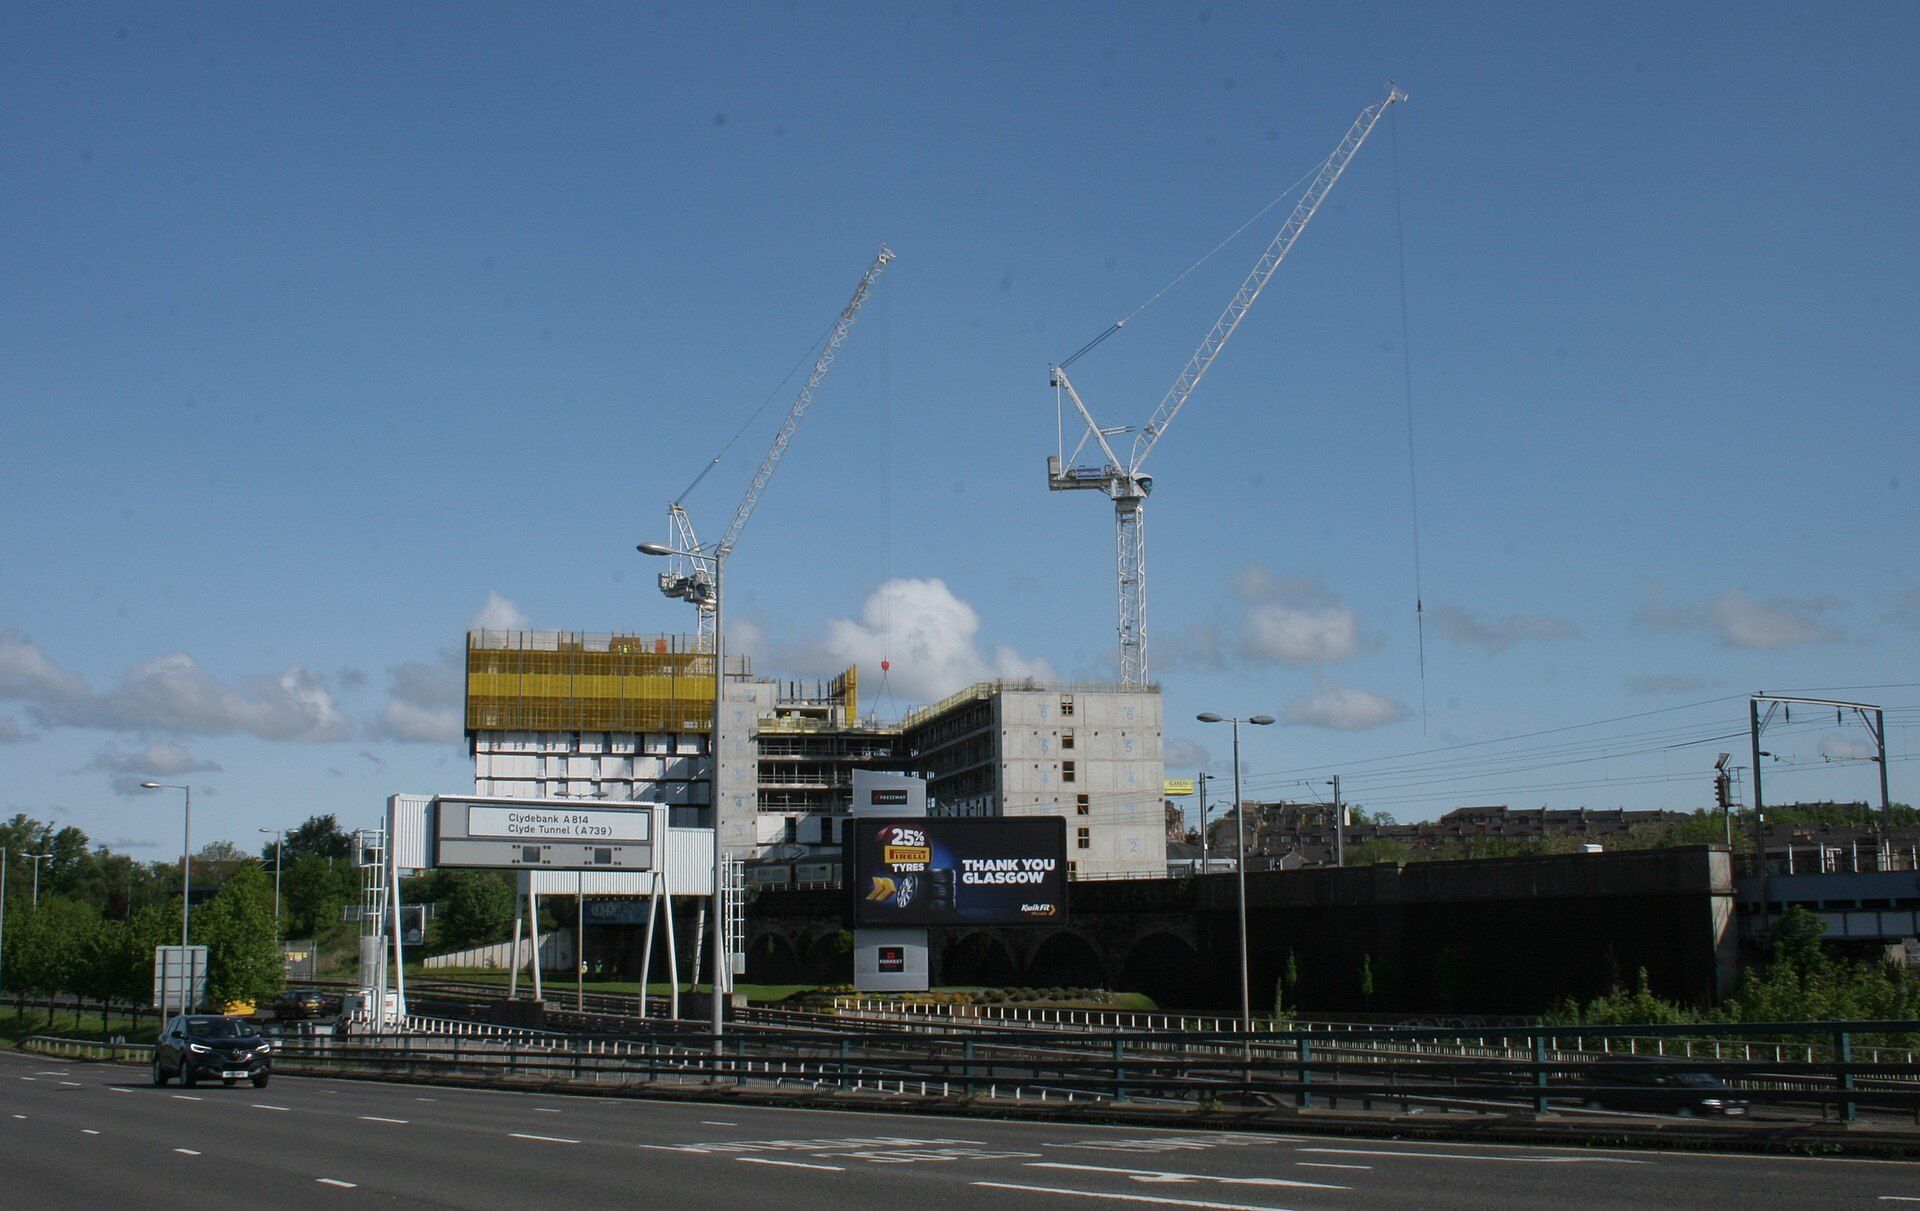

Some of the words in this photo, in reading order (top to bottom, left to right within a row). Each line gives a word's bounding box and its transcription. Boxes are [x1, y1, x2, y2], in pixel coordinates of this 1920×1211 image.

[508, 813, 559, 825] Clydebank
[508, 824, 535, 836] Clyde
[539, 825, 570, 835] Tunnel
[575, 826, 613, 836] (A739)
[891, 828, 925, 846] 25%
[889, 849, 926, 860] PIRELLI
[892, 863, 925, 872] TYRES
[962, 859, 1018, 871] THANK
[1021, 859, 1055, 871] YOU
[962, 871, 1045, 884] GLASGOW
